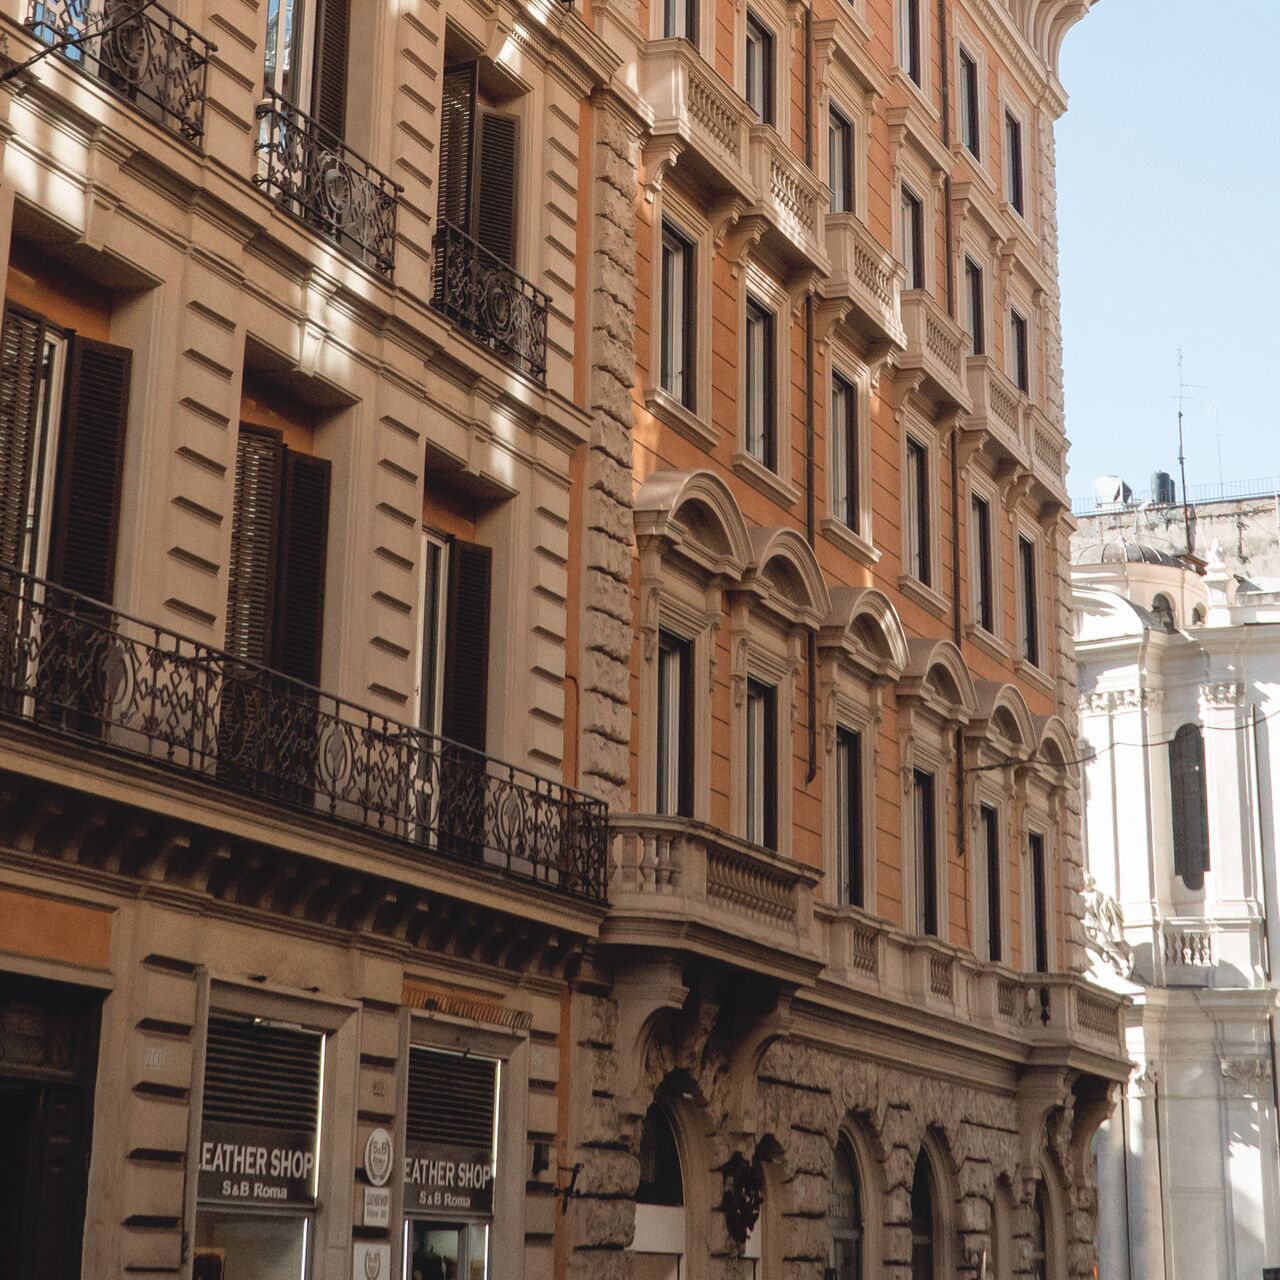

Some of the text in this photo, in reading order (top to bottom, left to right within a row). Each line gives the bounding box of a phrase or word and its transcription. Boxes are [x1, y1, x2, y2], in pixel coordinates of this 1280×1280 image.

[198, 1141, 314, 1179] EATHER SHOP
[404, 1157, 491, 1190] EATHER SHOP
[253, 1182, 288, 1199] Roma
[444, 1192, 471, 1208] Roma
